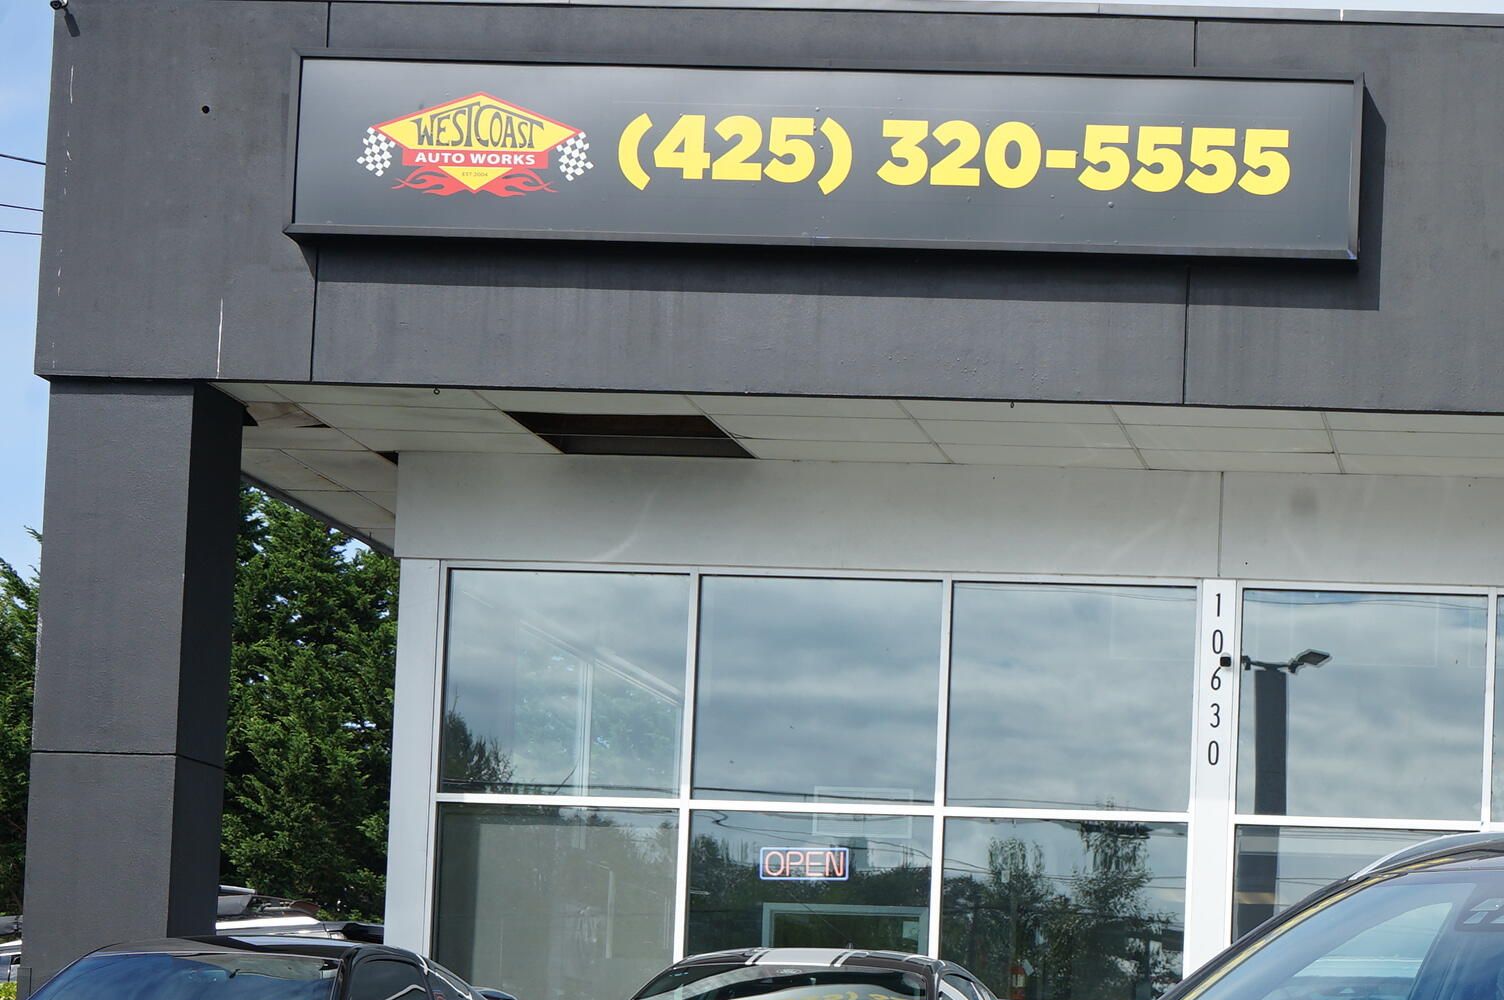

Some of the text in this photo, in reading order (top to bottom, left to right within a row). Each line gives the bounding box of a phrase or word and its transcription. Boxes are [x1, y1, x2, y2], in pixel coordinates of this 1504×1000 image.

[415, 152, 536, 165] AUTO WORKS
[618, 112, 1291, 195] (425) 320-5555
[764, 850, 845, 877] OPEN
